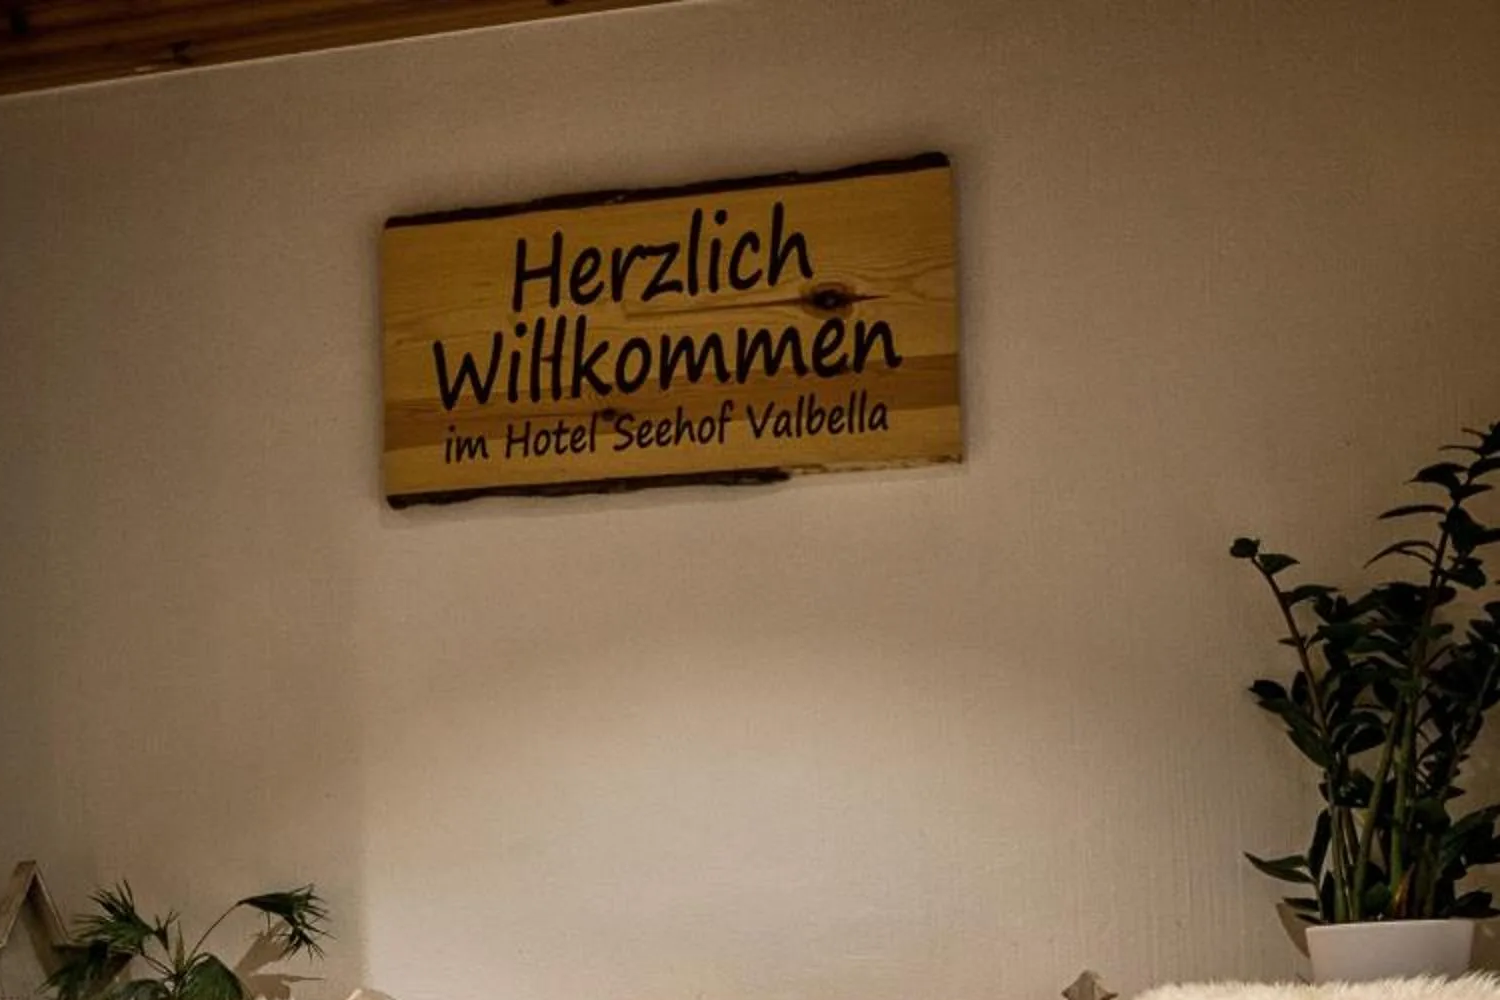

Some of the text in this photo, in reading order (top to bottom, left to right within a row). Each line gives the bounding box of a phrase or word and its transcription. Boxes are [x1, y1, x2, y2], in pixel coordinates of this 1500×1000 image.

[511, 202, 813, 312] Herzlich
[433, 314, 902, 411] Willkommen
[445, 390, 889, 464] im Hotel Seehof Valbella
